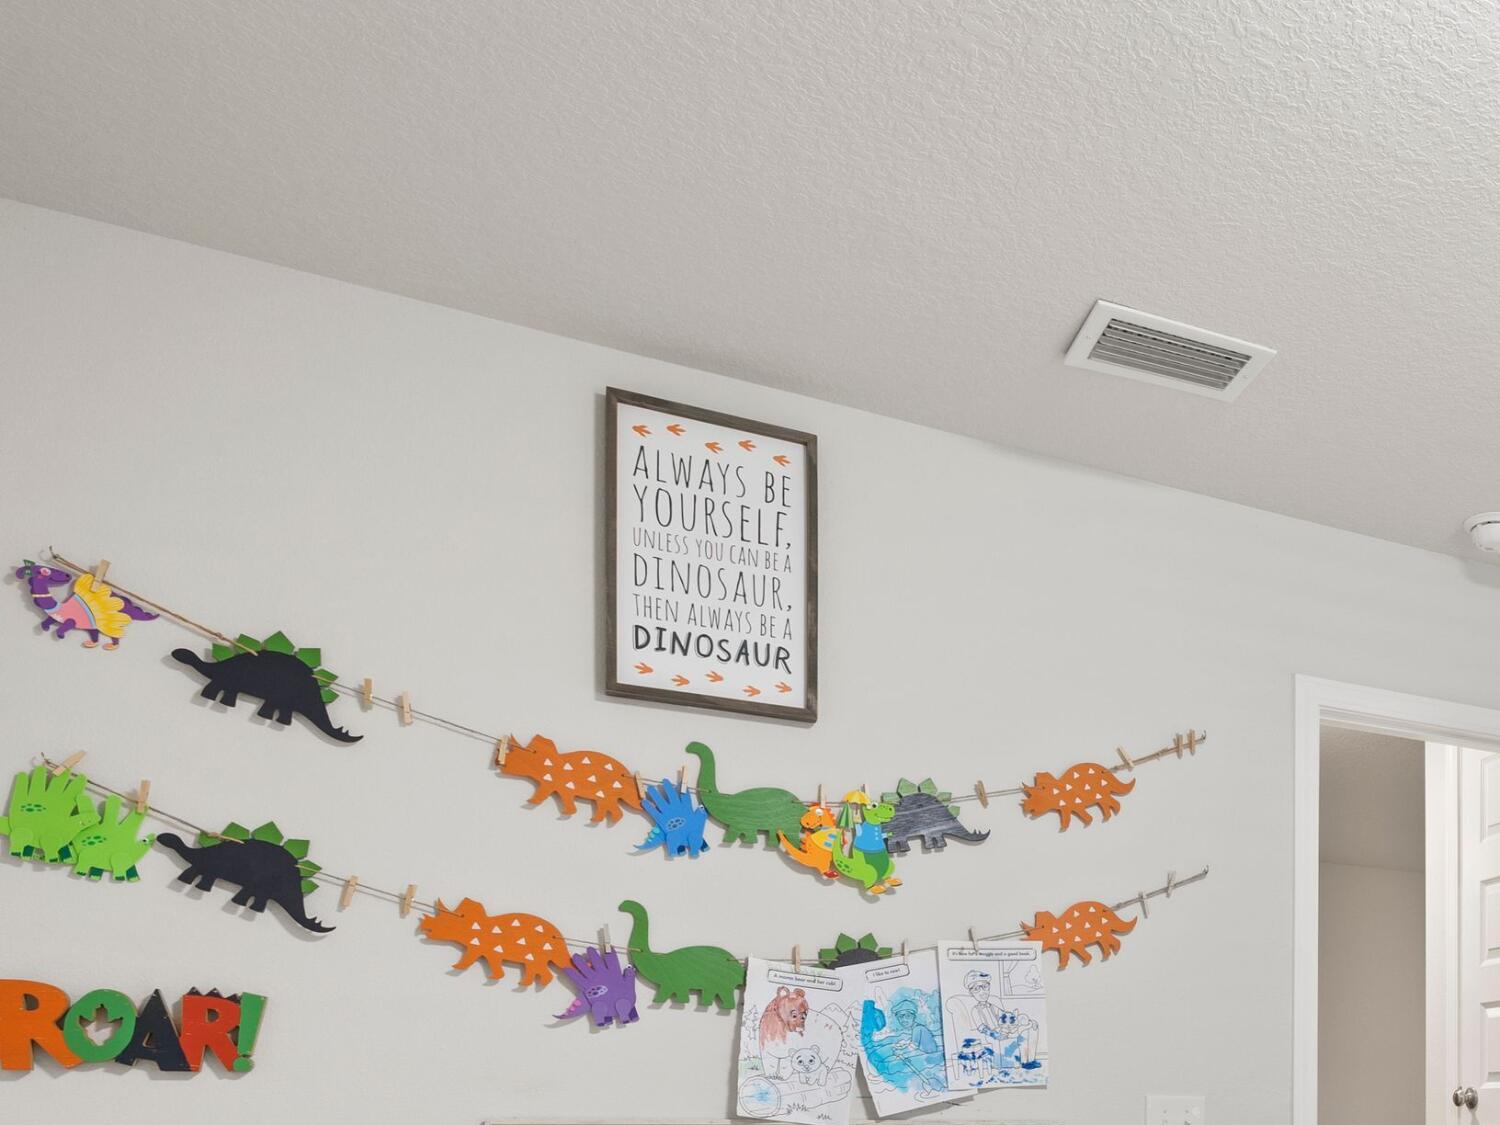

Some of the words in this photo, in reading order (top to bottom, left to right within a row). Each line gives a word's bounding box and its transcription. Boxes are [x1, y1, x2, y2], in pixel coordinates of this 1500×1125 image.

[633, 446, 746, 498] ALWAYS
[764, 471, 791, 507] BE
[633, 484, 792, 549] YOURSELF,
[633, 528, 689, 556] UNLESS
[696, 539, 724, 561] YOU
[730, 545, 758, 567] CAN
[765, 553, 779, 571] BE
[784, 556, 791, 573] A
[634, 554, 792, 612] DINOSAUR,
[633, 594, 678, 622] THEN
[688, 604, 751, 634] ALWAYS
[760, 614, 776, 637] BE
[783, 619, 792, 640] A
[634, 625, 792, 674] DINOSAUR
